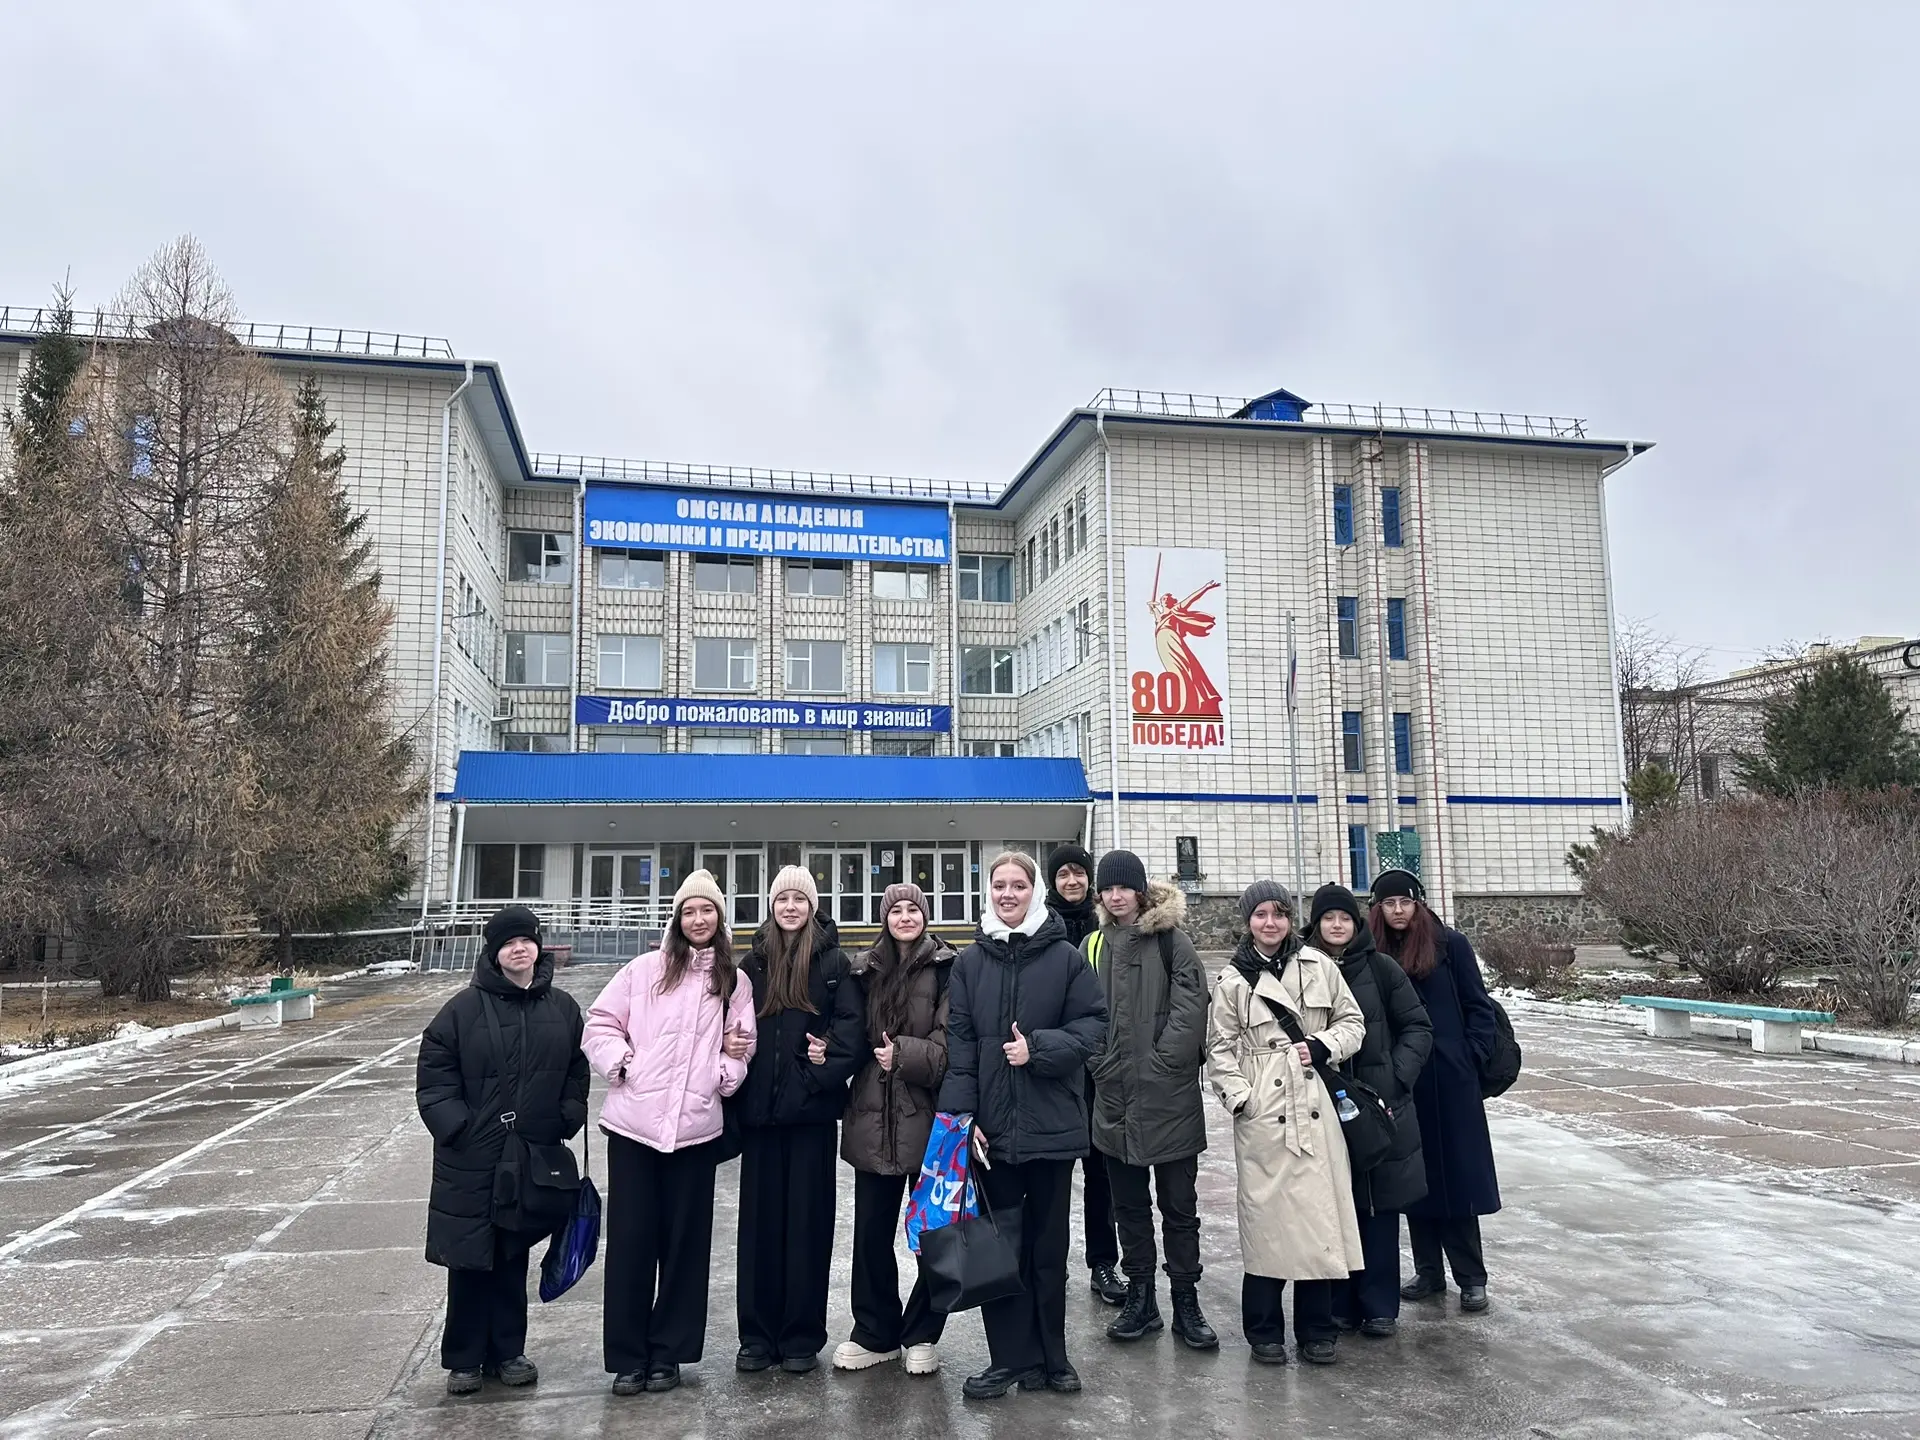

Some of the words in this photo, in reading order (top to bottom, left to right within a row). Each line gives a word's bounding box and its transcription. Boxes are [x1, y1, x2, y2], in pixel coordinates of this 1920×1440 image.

[676, 498, 757, 523] ОМСКАЯ
[760, 504, 864, 528] АКАДЕМИЯ
[589, 519, 706, 546] ЭКОНОМИКИ
[710, 526, 722, 547] И
[726, 528, 946, 558] ПРЕДПРИНИМАТЕЛЬСТВА
[1131, 670, 1181, 714] 80
[607, 700, 670, 725] Добро
[675, 705, 800, 724] пожаловать
[804, 708, 816, 724] в
[821, 709, 858, 729] мир
[863, 708, 932, 727] знаний!
[1132, 722, 1225, 750] ПОБЕДА!
